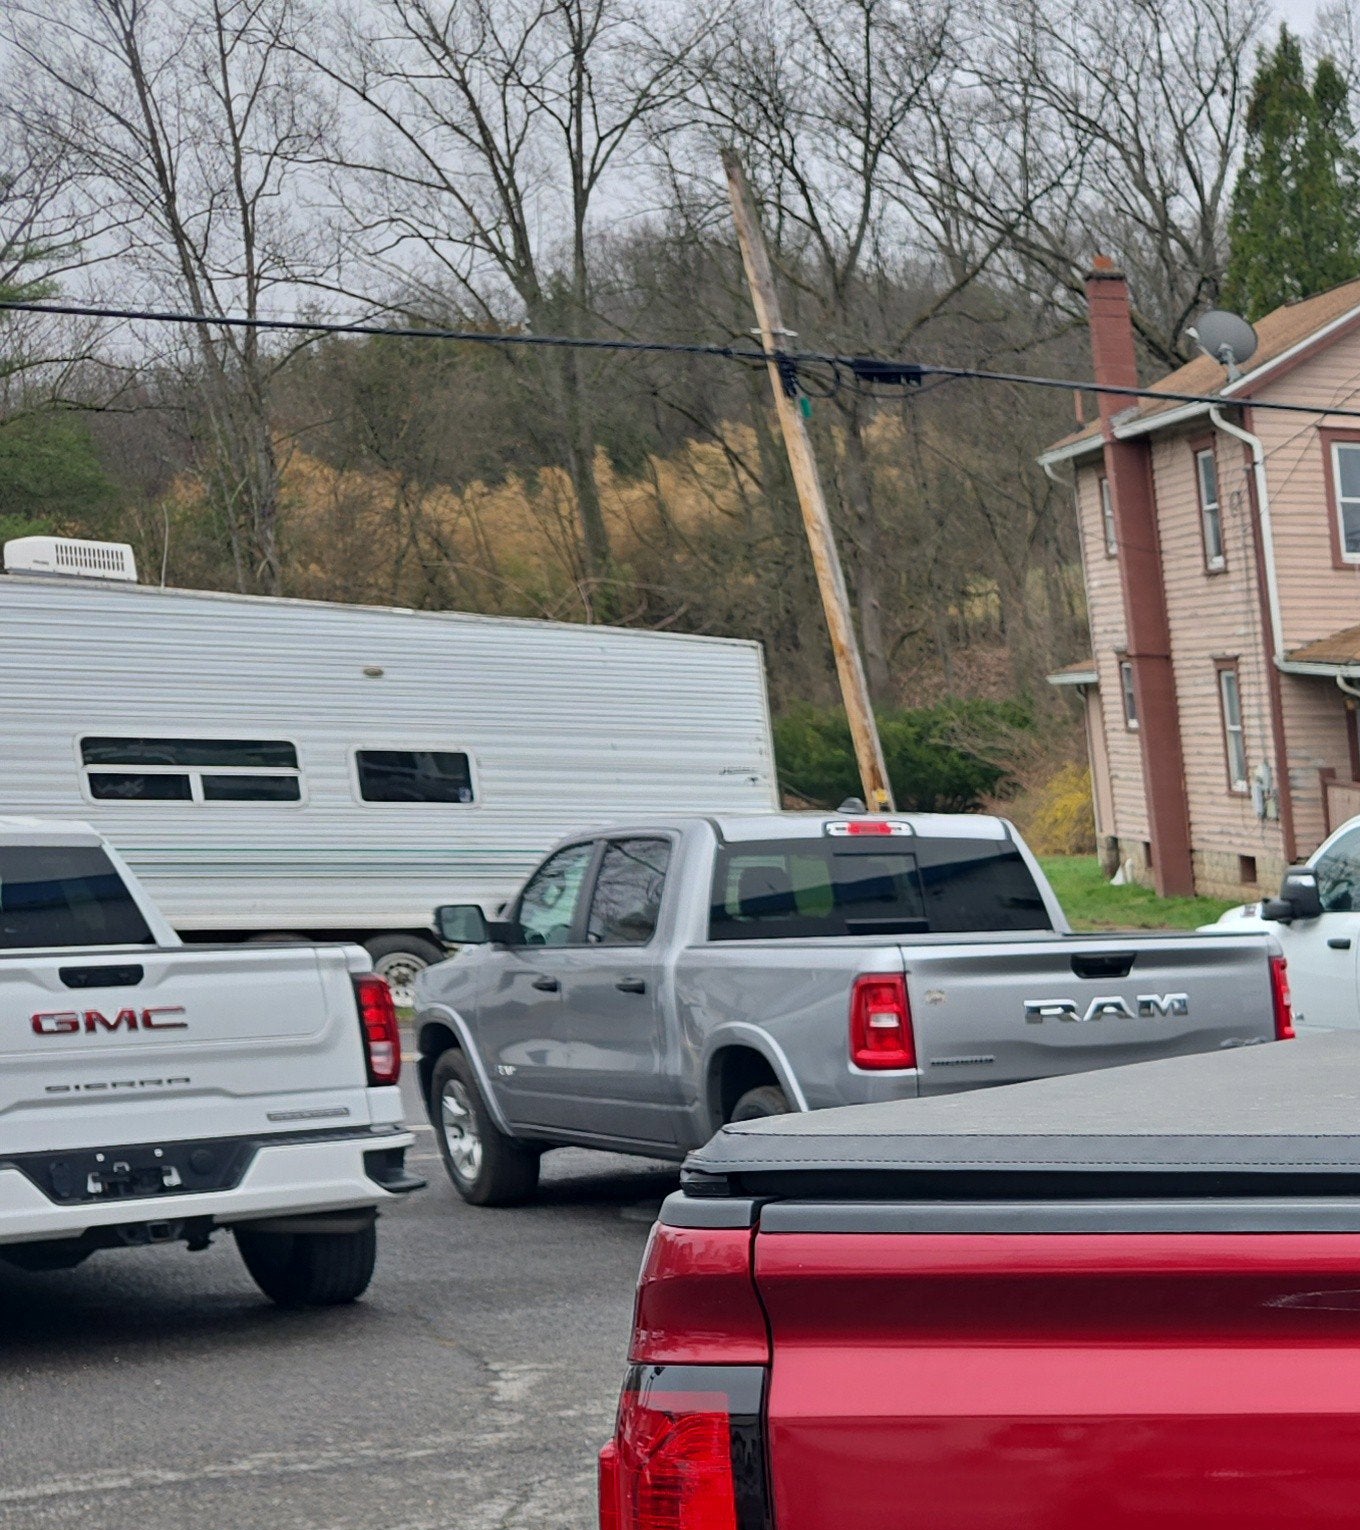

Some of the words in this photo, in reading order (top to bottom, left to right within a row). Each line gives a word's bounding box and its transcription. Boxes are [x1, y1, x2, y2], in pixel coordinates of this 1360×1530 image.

[31, 1006, 188, 1035] GMC
[1023, 992, 1190, 1025] RAM
[45, 1077, 191, 1093] SIERRA
